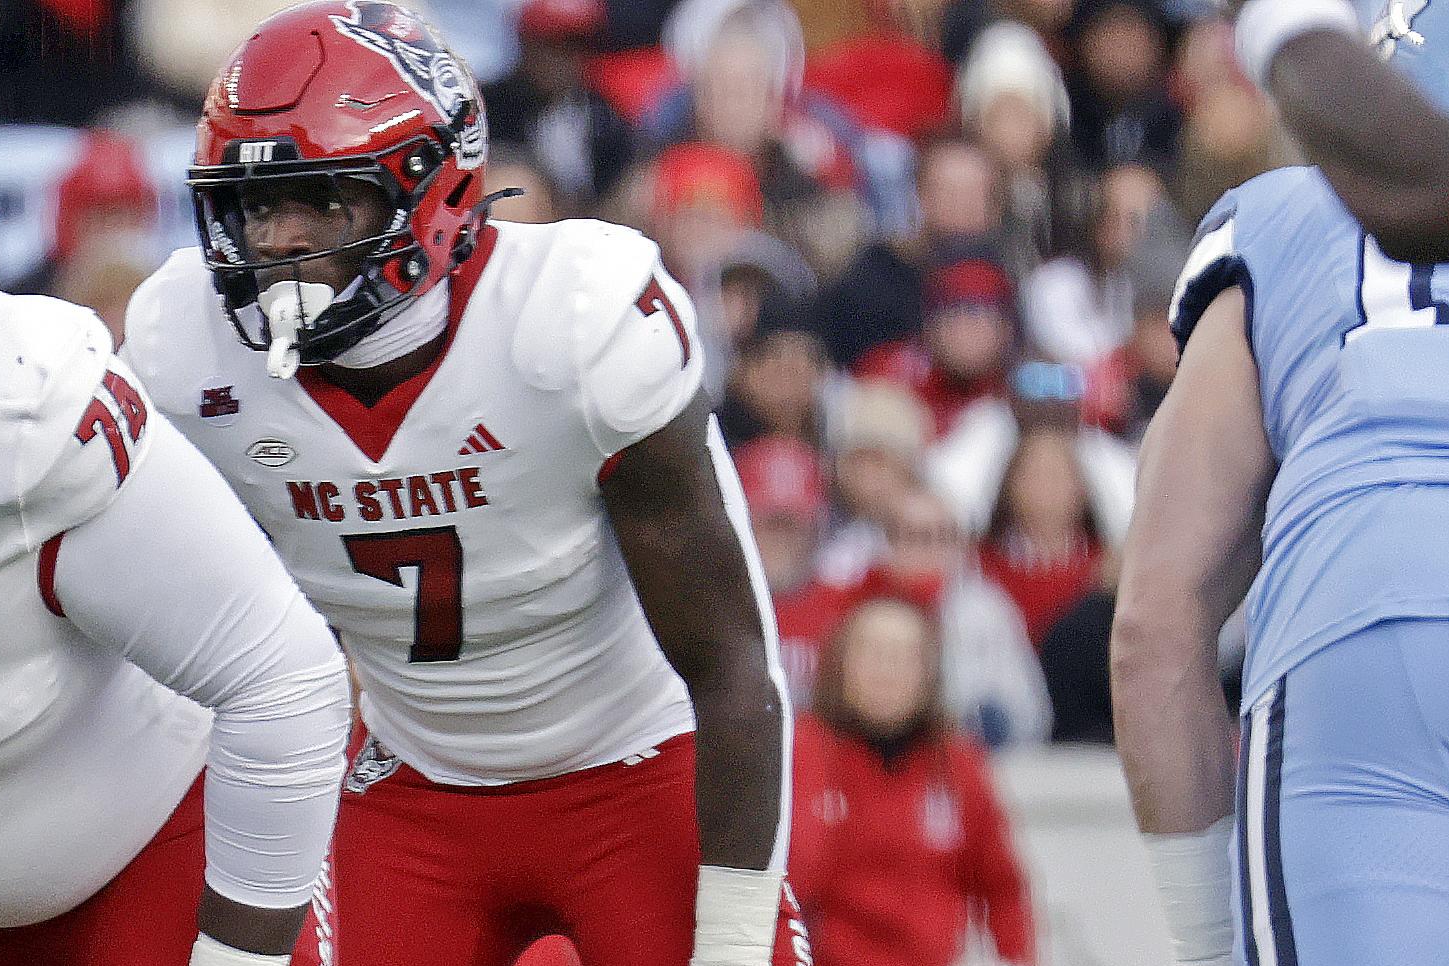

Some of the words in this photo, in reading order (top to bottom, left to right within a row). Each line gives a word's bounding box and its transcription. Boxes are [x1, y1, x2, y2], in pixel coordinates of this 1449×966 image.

[633, 273, 691, 371] 7
[287, 481, 345, 522] NC
[354, 466, 490, 522] STATE
[340, 525, 464, 663] 7
